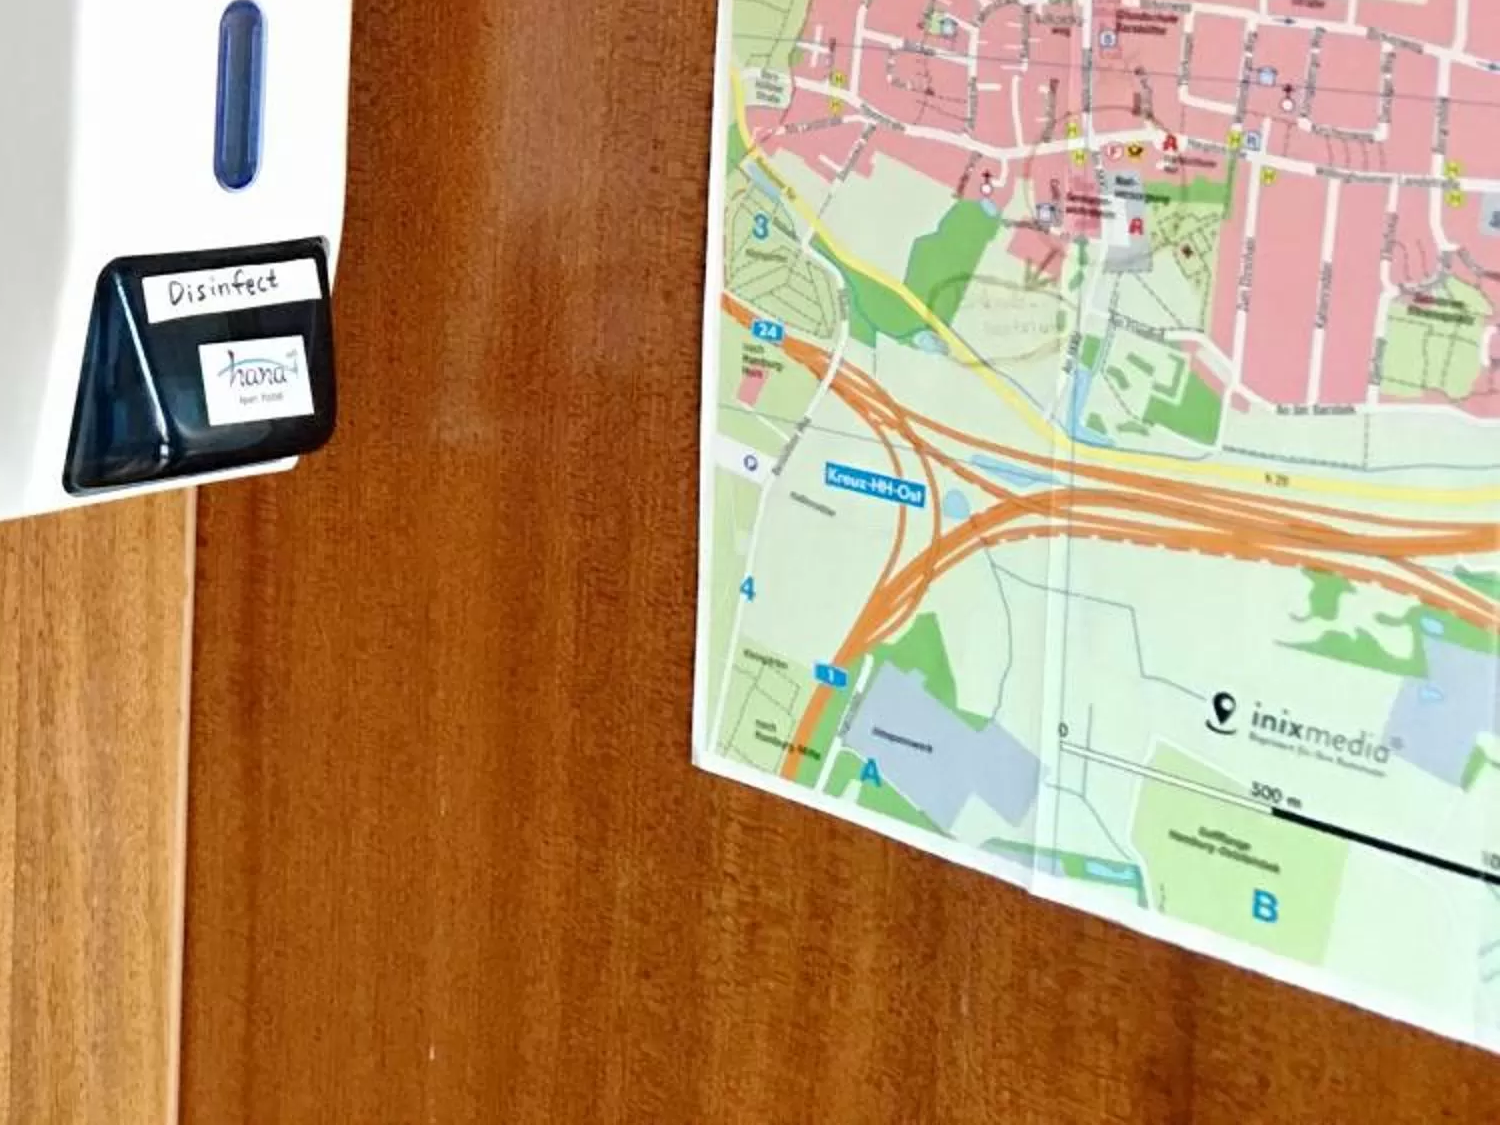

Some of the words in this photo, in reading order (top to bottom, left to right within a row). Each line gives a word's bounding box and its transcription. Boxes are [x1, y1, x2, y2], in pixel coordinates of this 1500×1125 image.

[751, 213, 769, 240] 3
[168, 268, 280, 306] Disinfect
[758, 323, 778, 339] 24
[739, 576, 757, 601] 4
[1251, 700, 1391, 764] inixmedia
[861, 758, 882, 787] A
[1252, 781, 1283, 803] 500
[1252, 888, 1279, 923] B
